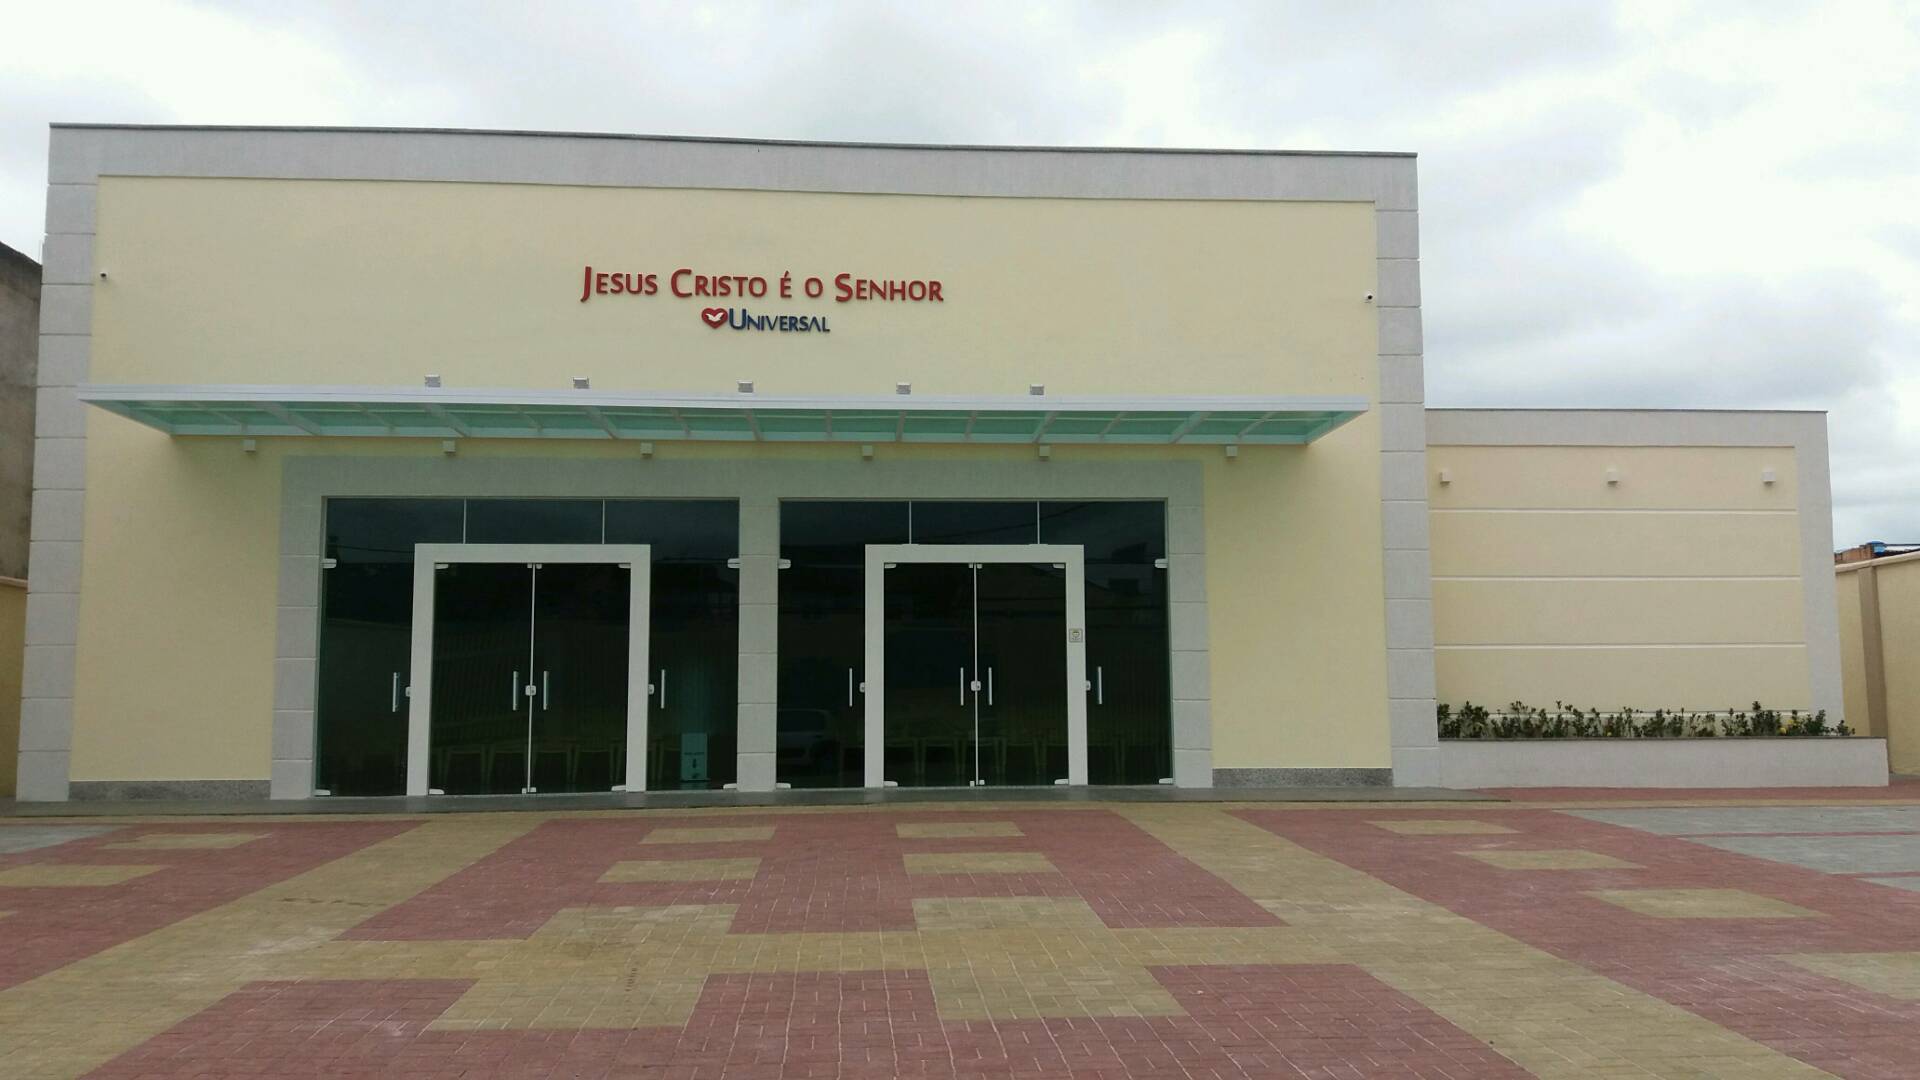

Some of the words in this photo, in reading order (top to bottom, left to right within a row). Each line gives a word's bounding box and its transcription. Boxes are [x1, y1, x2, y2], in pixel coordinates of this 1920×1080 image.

[580, 266, 658, 302] JESUS
[670, 269, 767, 299] CRISTO
[804, 277, 824, 299] O
[835, 273, 944, 303] SENHOR
